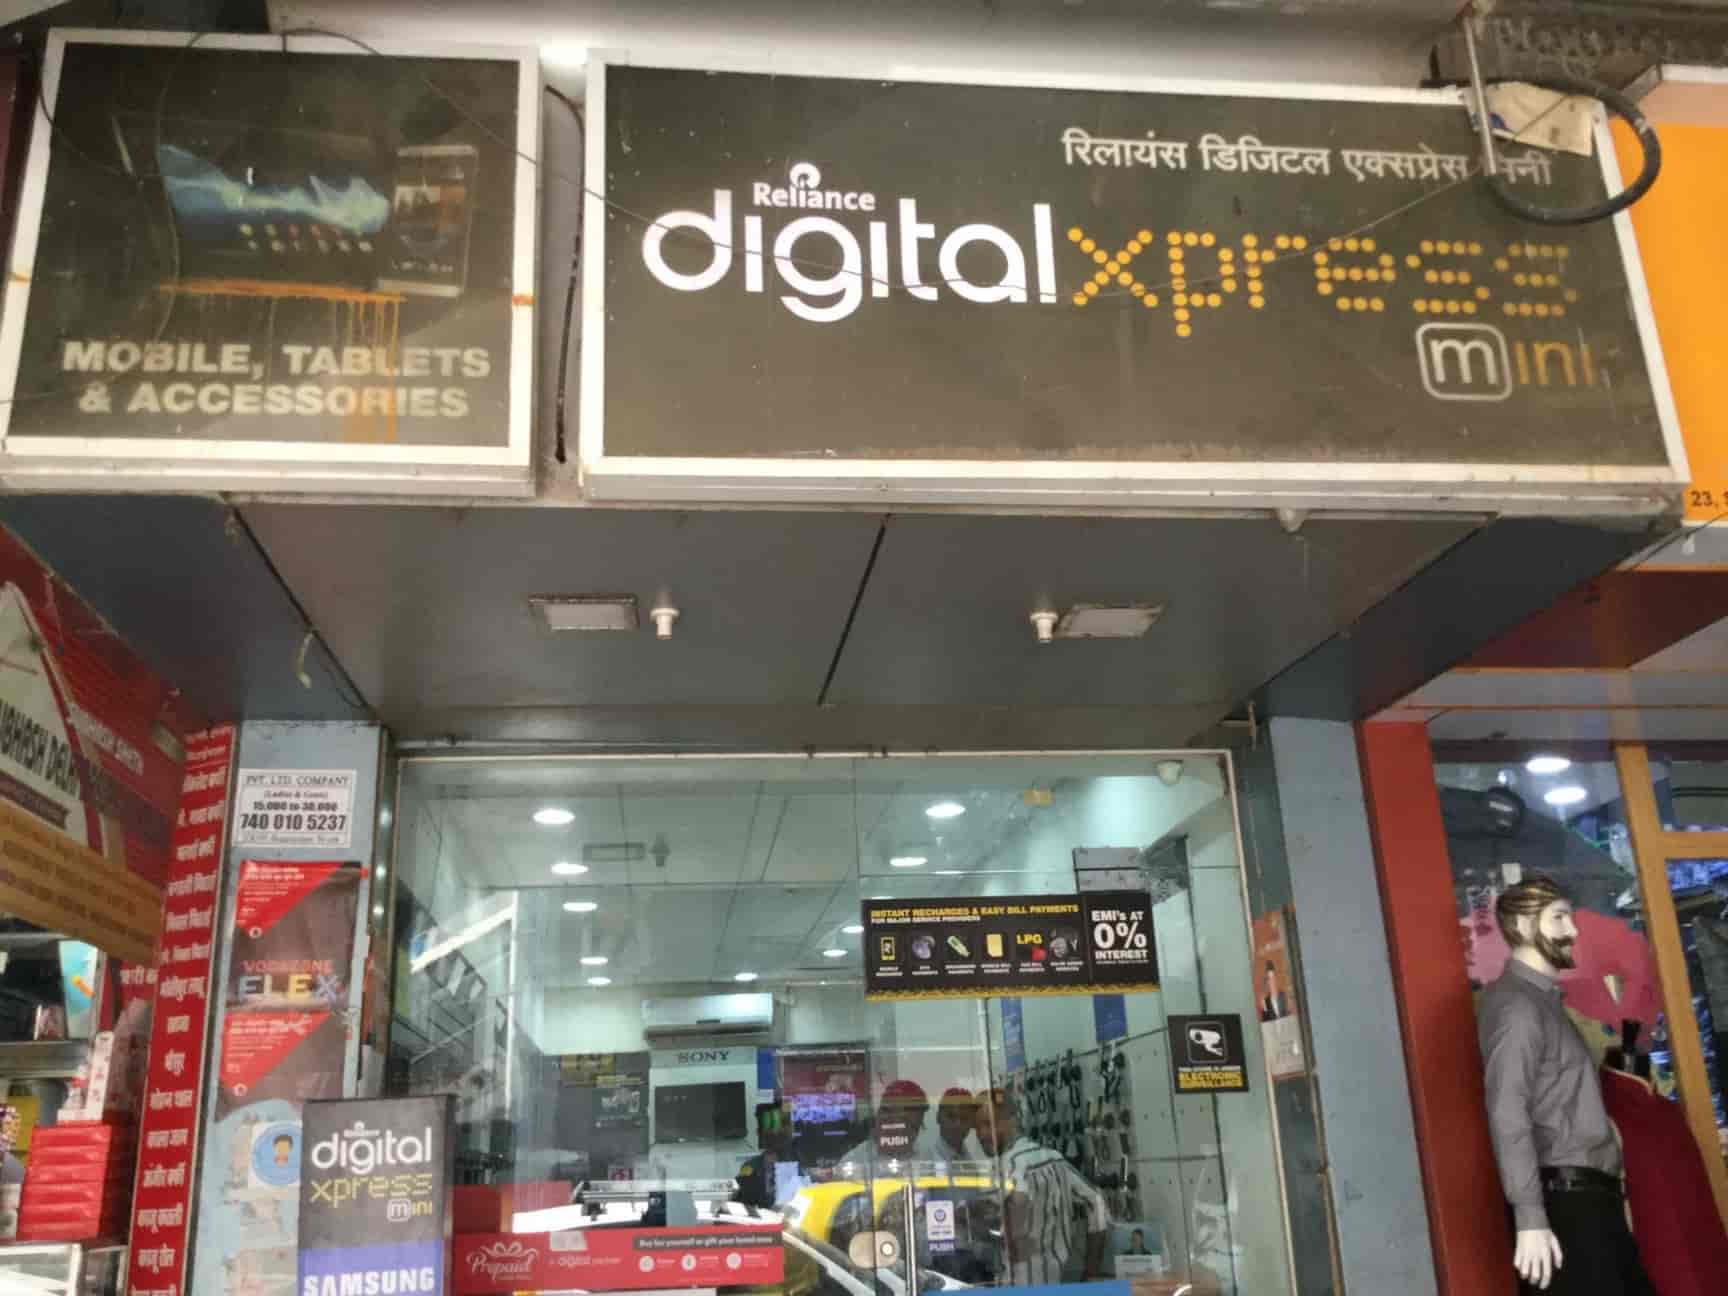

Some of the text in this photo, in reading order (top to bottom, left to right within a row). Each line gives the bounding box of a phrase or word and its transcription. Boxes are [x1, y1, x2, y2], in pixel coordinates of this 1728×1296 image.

[1061, 127, 1552, 185] रिलायंस डिजिटल एक्सप्रेस नी
[752, 181, 877, 211] Reliance
[643, 188, 1579, 338] digital xpress
[63, 341, 491, 380] MOBILE, TABLETS
[1429, 338, 1593, 386] mini
[79, 381, 470, 417] & ACCESSORIES
[295, 775, 349, 785] COMPANY
[240, 813, 269, 829] 740
[273, 813, 303, 830] 010
[307, 814, 347, 830] 5237
[1007, 906, 1026, 915] BILL
[1030, 904, 1080, 914] PAYMENTS
[1130, 911, 1144, 921] AT
[1016, 934, 1042, 945] LPG
[1094, 921, 1147, 949] 0%
[1095, 949, 1148, 960] INTEREST
[677, 1050, 731, 1065] SONY
[311, 1126, 432, 1175] digital
[880, 1135, 909, 1147] PUSH
[310, 1173, 433, 1209] xpress
[390, 1200, 433, 1218] mini
[466, 1248, 540, 1284] Prepaid
[303, 1266, 436, 1296] SAMSUNG
